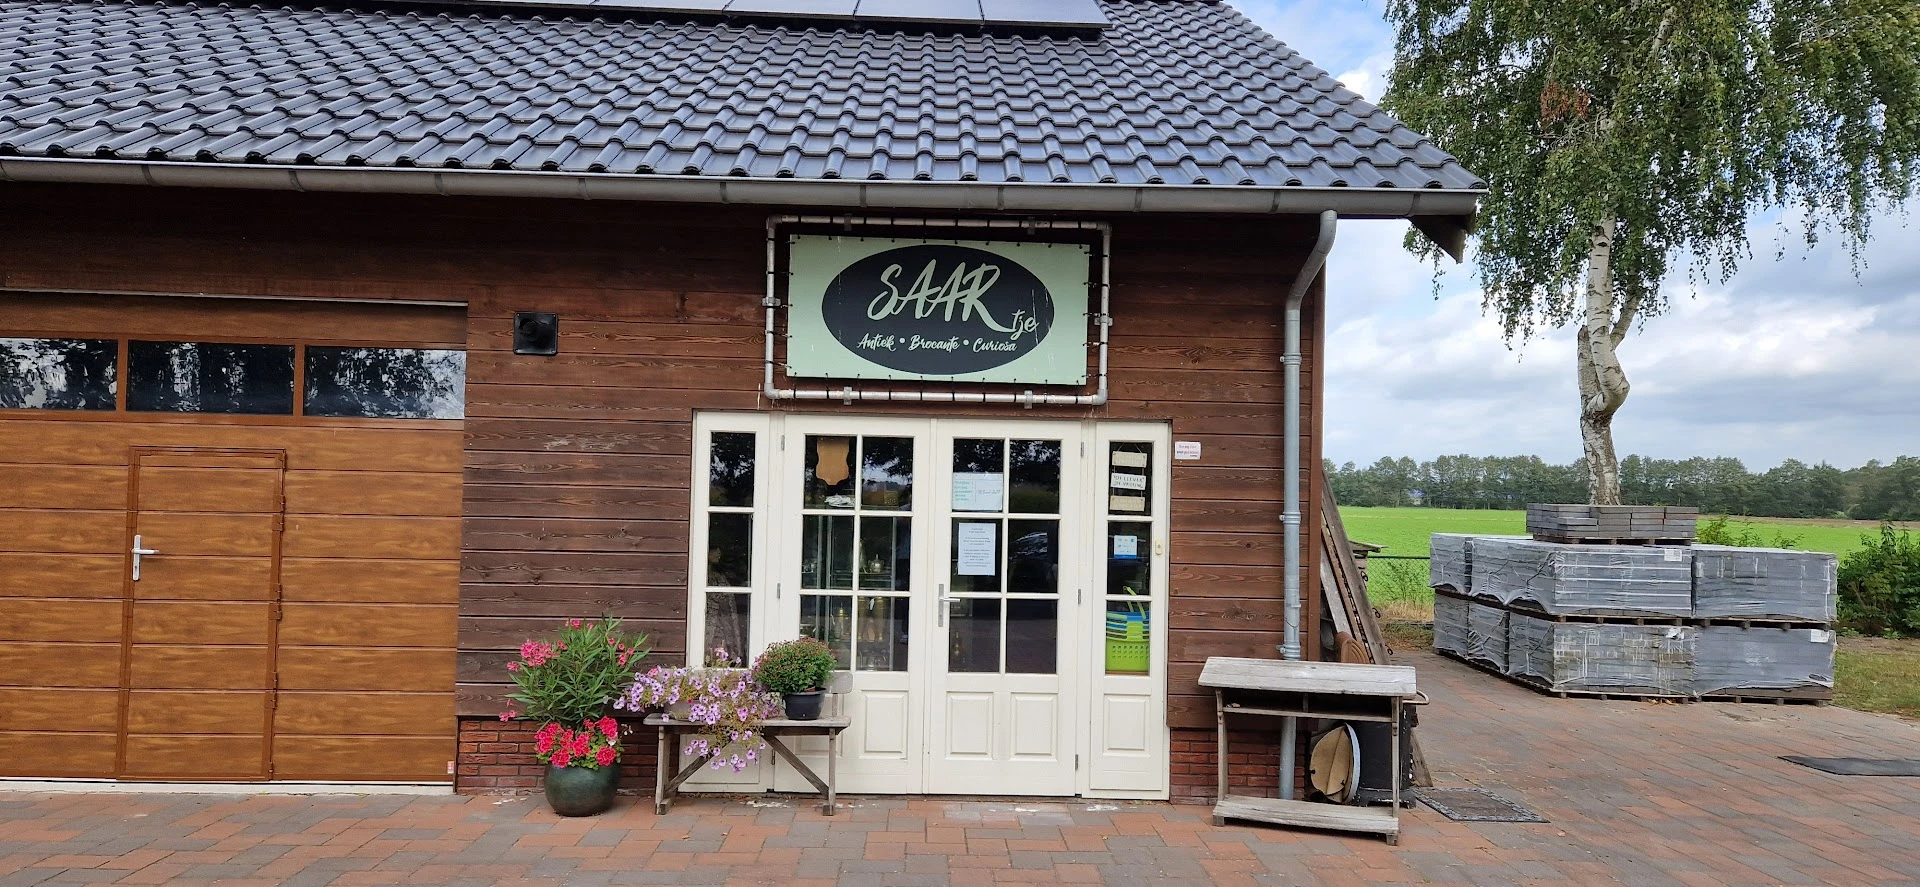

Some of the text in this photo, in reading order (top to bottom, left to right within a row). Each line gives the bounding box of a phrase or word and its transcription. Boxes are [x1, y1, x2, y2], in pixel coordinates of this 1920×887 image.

[867, 259, 1015, 333] SAAR
[908, 335, 960, 353] Brocante
[972, 338, 1018, 353] Curiosa
